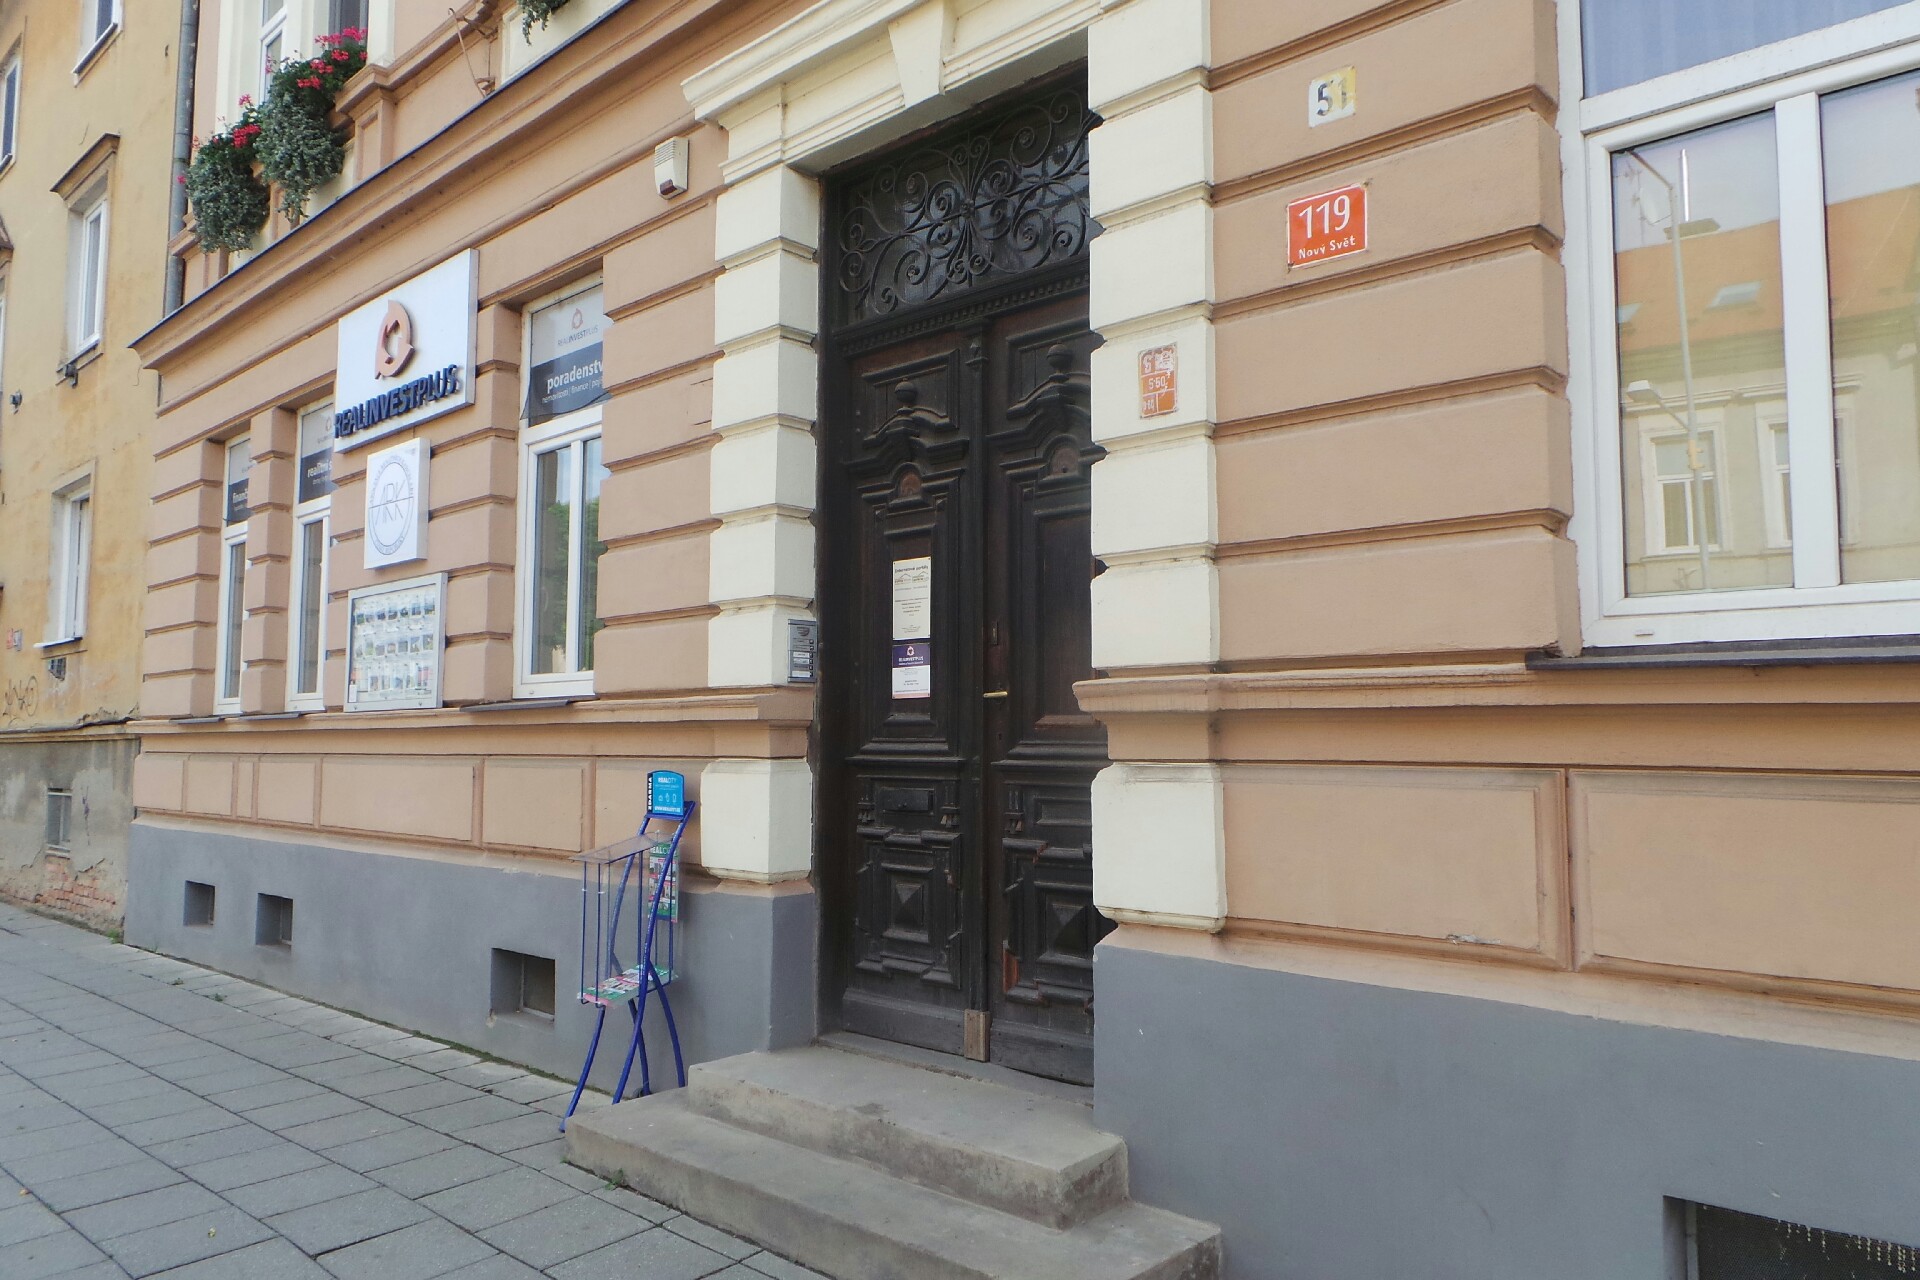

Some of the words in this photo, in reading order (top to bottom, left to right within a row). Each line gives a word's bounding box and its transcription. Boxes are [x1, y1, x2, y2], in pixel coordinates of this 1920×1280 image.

[1299, 194, 1351, 239] 119
[1299, 243, 1327, 260] Nový
[1329, 235, 1357, 252] Svět
[334, 363, 459, 439] REALINVESTPLUS
